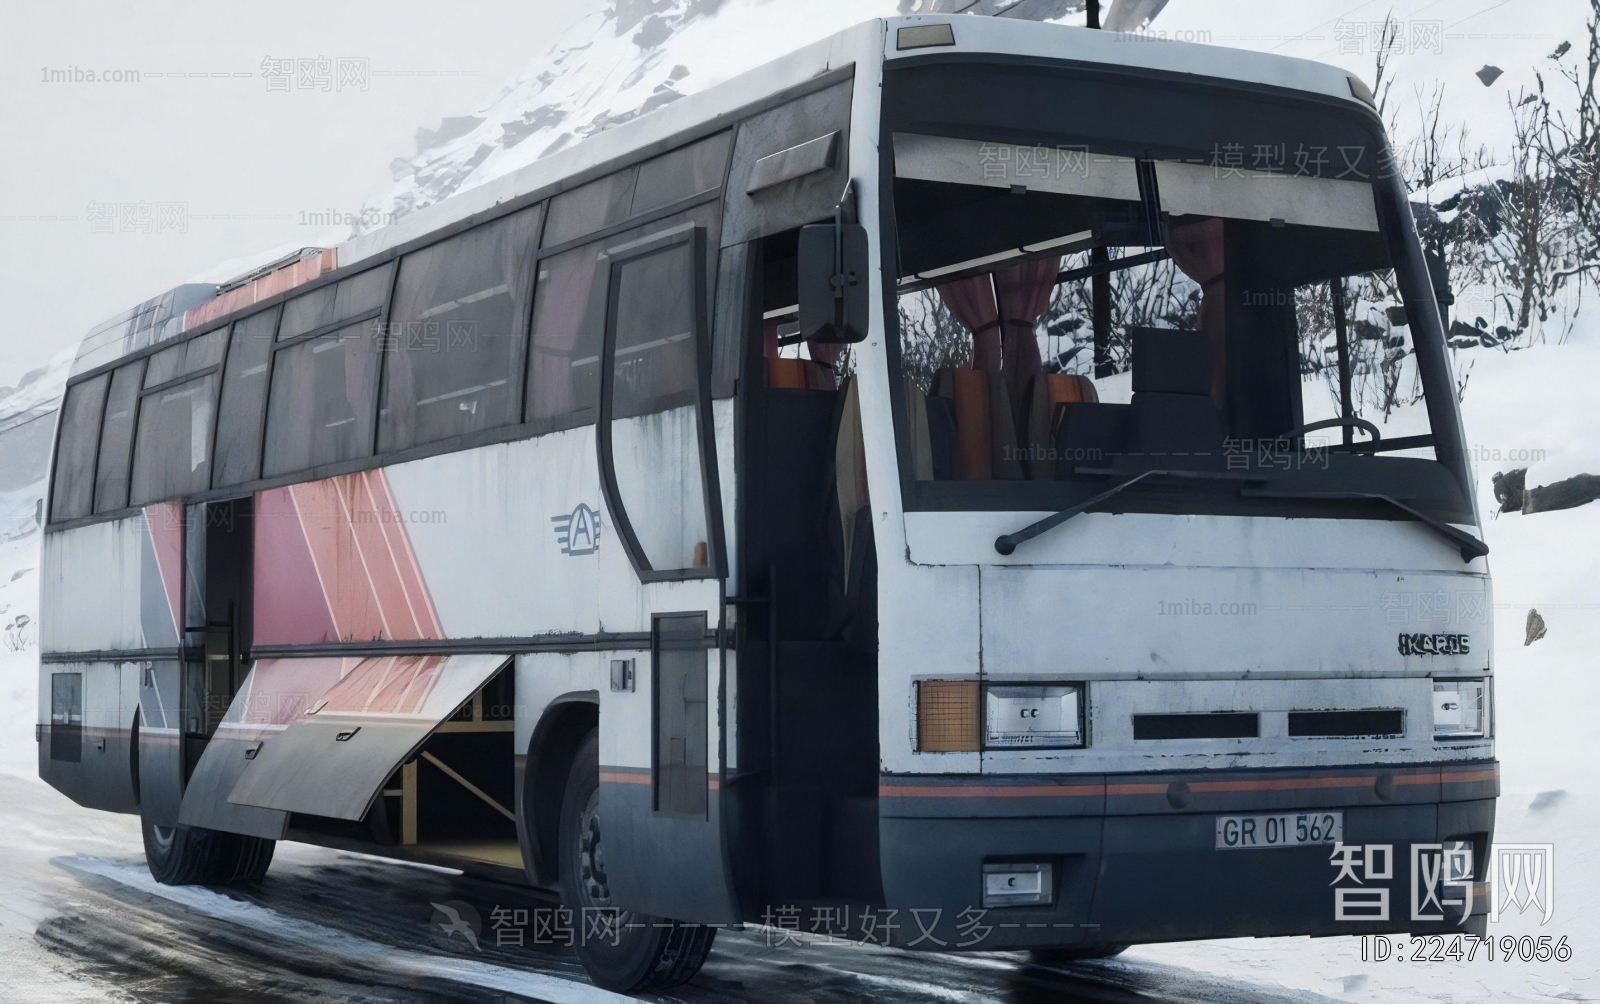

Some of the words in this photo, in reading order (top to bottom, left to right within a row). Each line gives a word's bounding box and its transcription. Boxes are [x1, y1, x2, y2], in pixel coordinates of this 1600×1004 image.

[1223, 819, 1256, 846] GR
[1265, 817, 1286, 844] 01
[1296, 814, 1335, 842] 562
